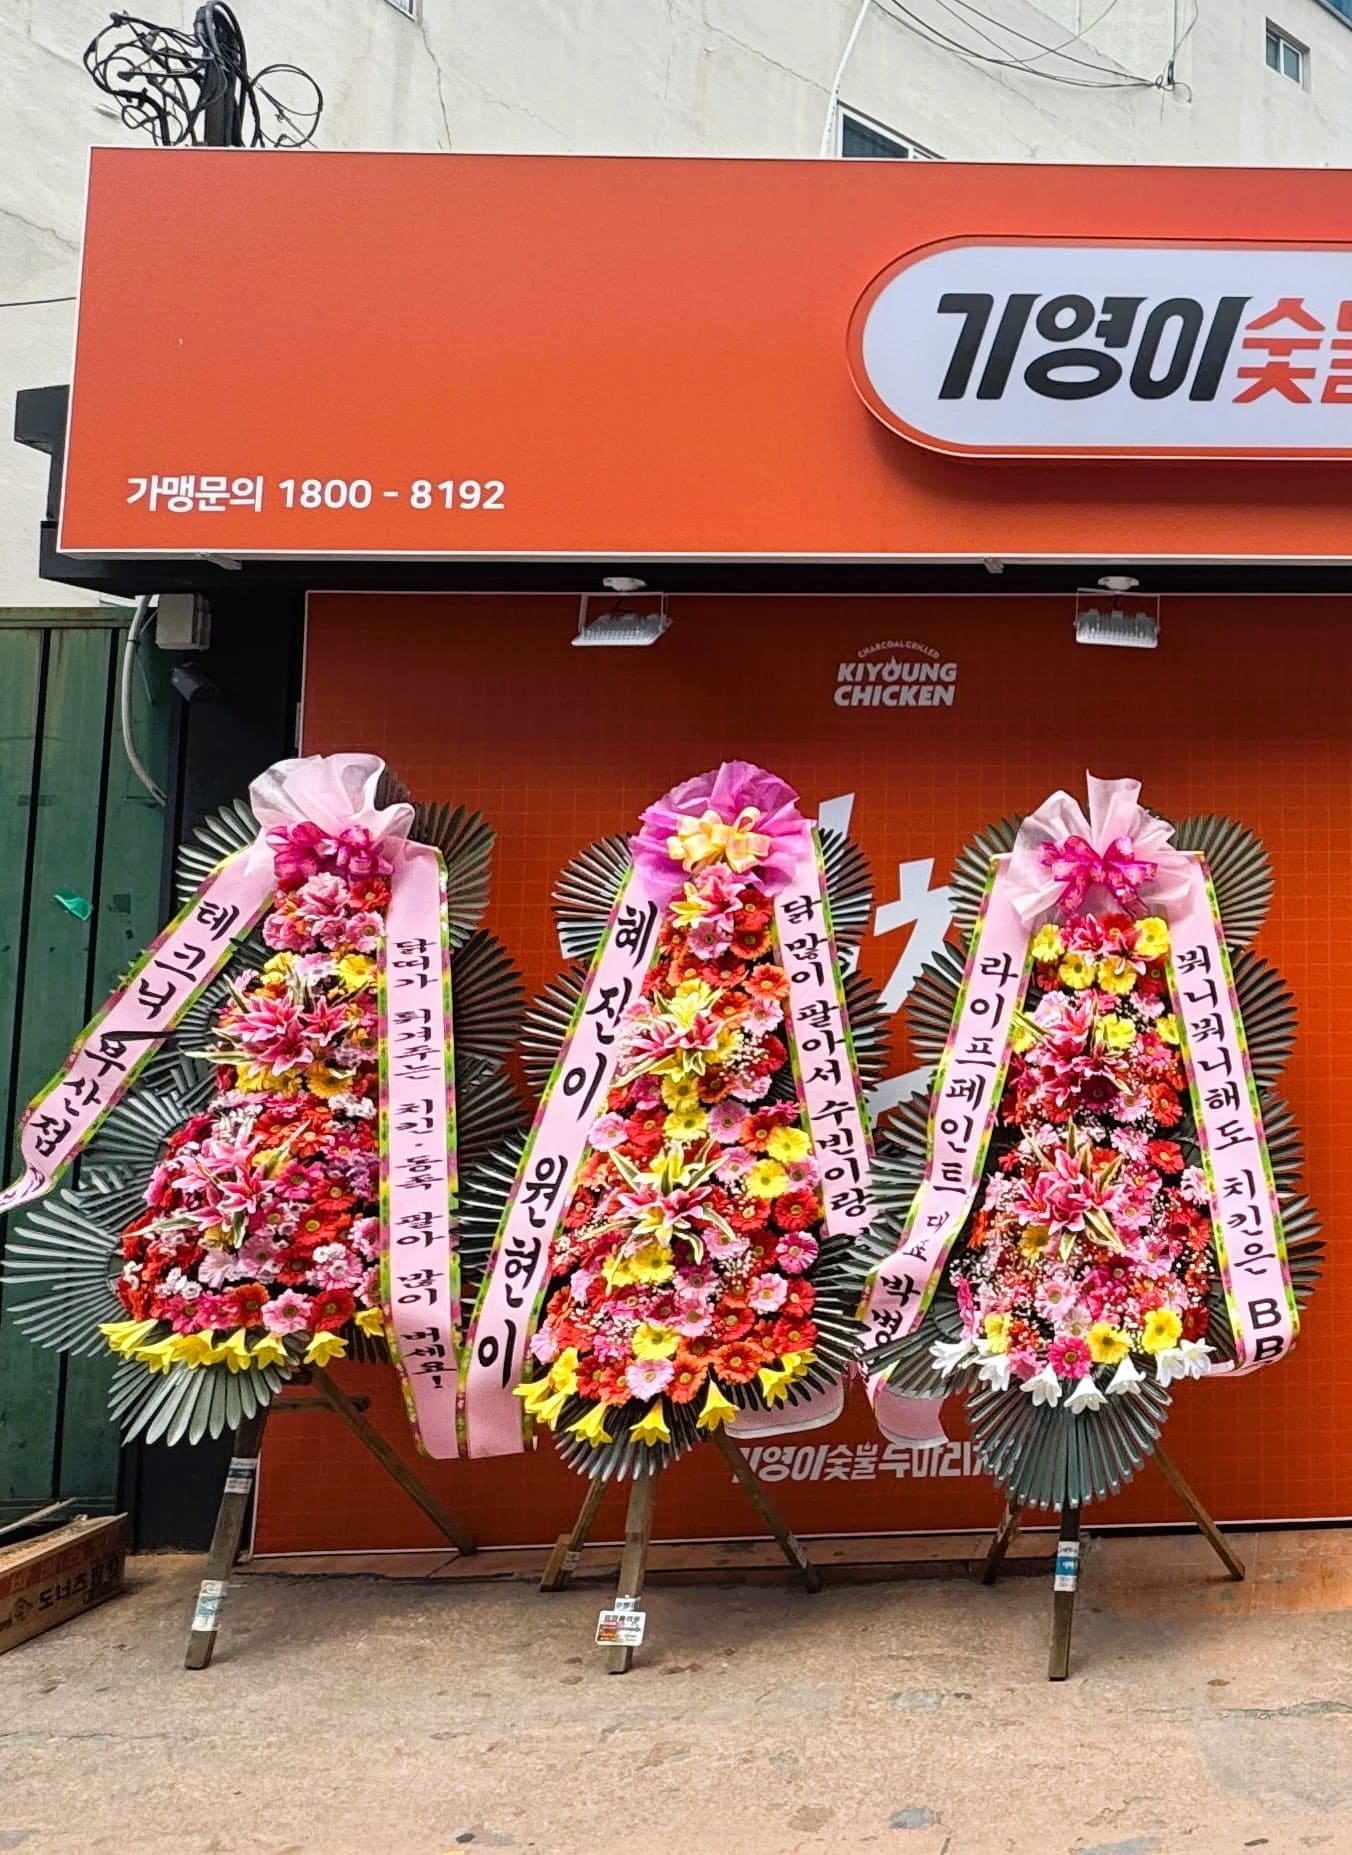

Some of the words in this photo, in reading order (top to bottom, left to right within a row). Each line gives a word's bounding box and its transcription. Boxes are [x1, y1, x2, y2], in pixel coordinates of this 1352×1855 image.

[126, 475, 264, 512] 가맹문의
[278, 479, 372, 509] 1800
[410, 479, 505, 510] 8192
[834, 685, 956, 706] CHICKEN
[837, 657, 957, 683] KIYOUNG
[138, 900, 239, 1020] 테크닉
[784, 933, 830, 988] 많이
[796, 1000, 848, 1088] 팔아서
[933, 952, 1019, 1195] 라이프페인트
[30, 1037, 126, 1158] 부산점
[818, 1100, 874, 1218] 수빈이랑
[395, 1212, 445, 1248] 팔아
[1222, 1168, 1277, 1276] 치킨은
[397, 1269, 444, 1306] 많이
[400, 1326, 457, 1390] 버세요!
